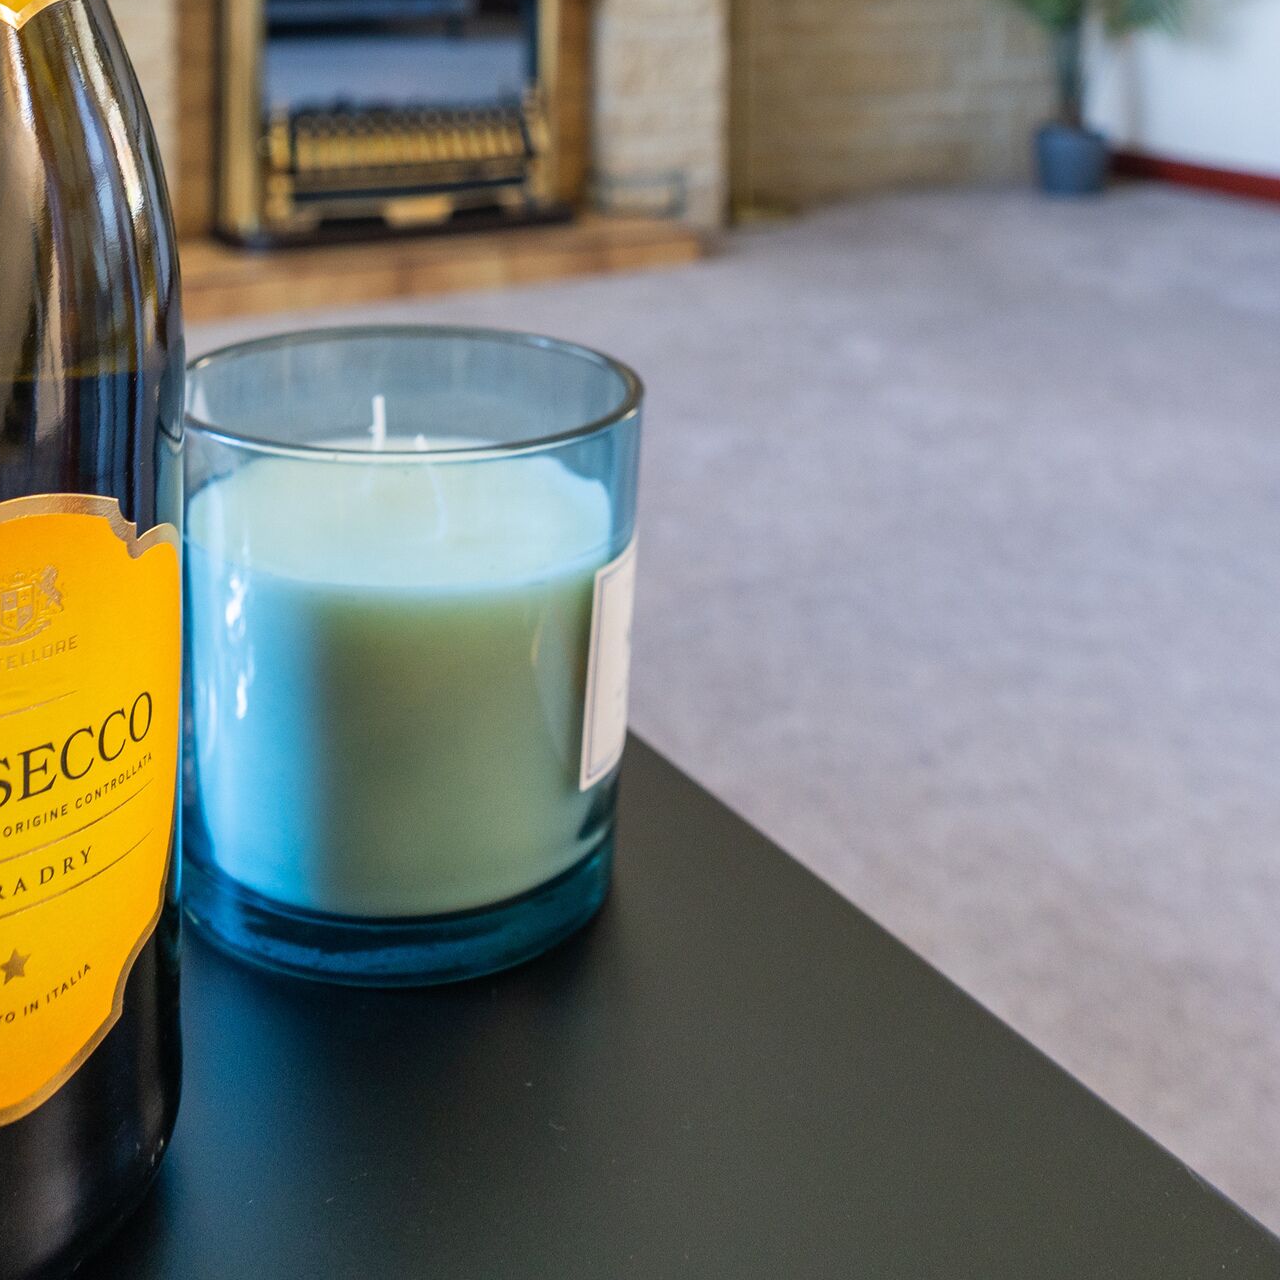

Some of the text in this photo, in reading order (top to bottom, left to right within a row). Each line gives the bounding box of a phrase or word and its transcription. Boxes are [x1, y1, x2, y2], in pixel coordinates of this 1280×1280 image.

[2, 803, 69, 838] ORIGINE
[75, 752, 153, 810] CONTROLLATA
[39, 845, 93, 886] DRY
[23, 999, 40, 1017] IN
[46, 962, 92, 1004] ITALIA
